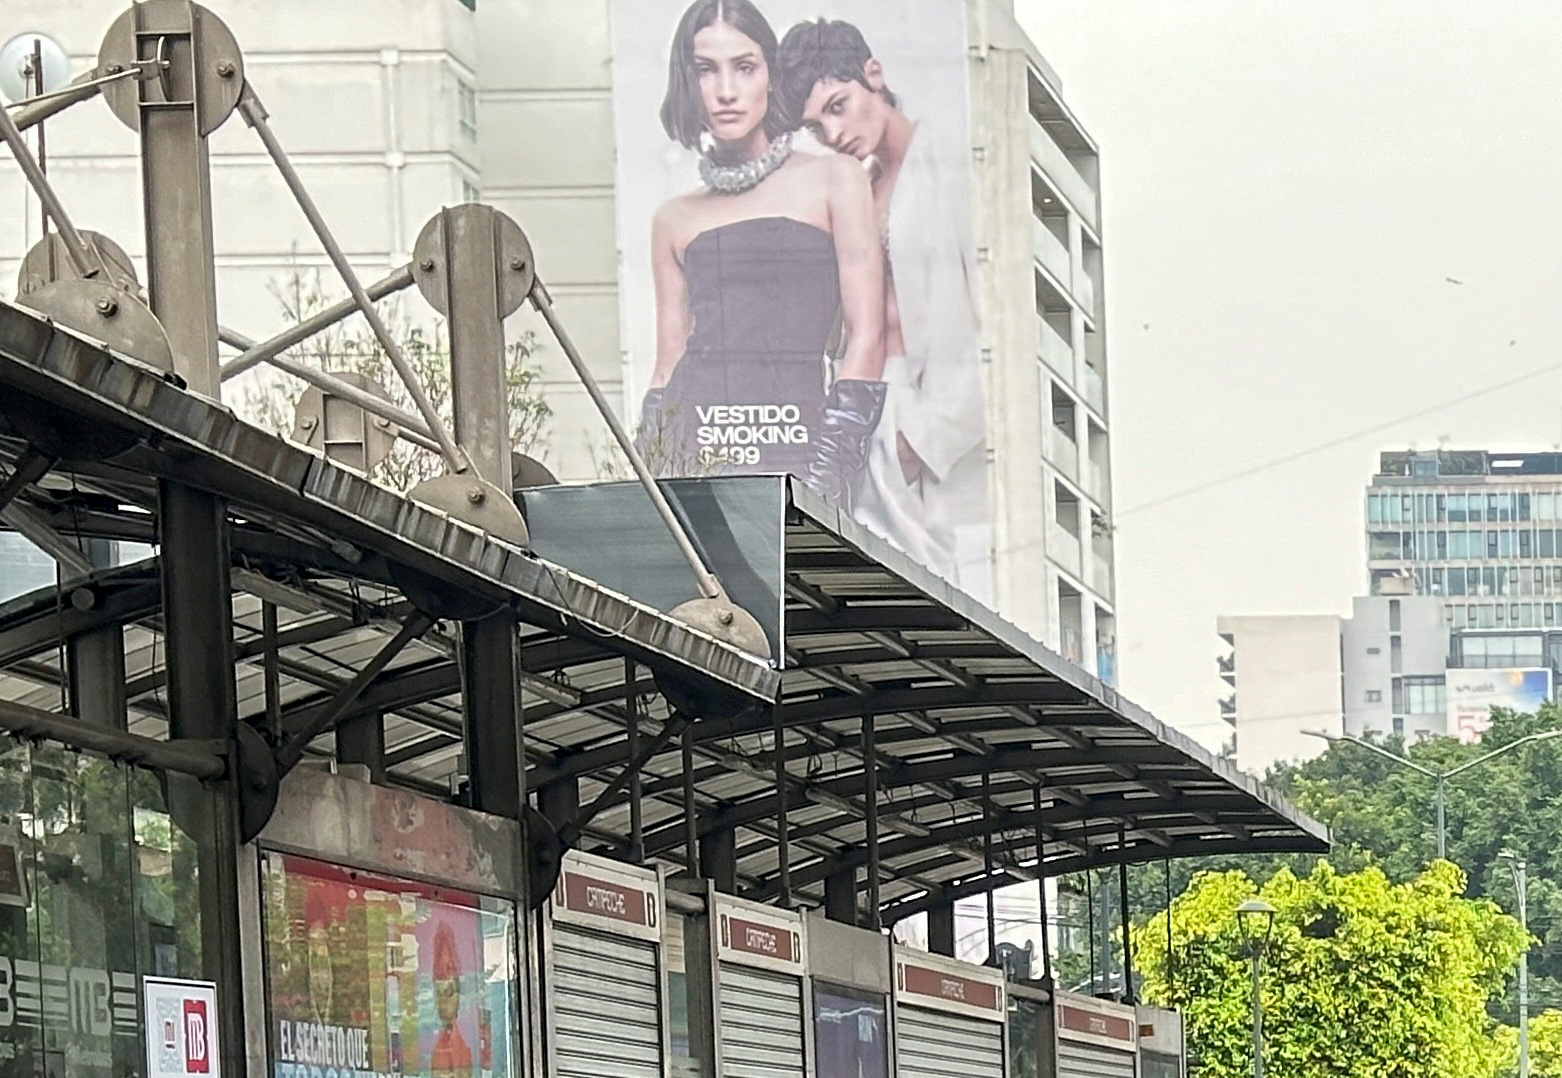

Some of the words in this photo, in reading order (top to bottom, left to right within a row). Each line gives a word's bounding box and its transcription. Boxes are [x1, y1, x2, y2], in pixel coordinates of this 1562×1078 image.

[695, 405, 800, 424] VESTIDO
[697, 425, 809, 444] SMOKING
[280, 1019, 295, 1061] EL
[295, 1021, 346, 1068] SECRETO
[347, 1027, 370, 1071] QUE
